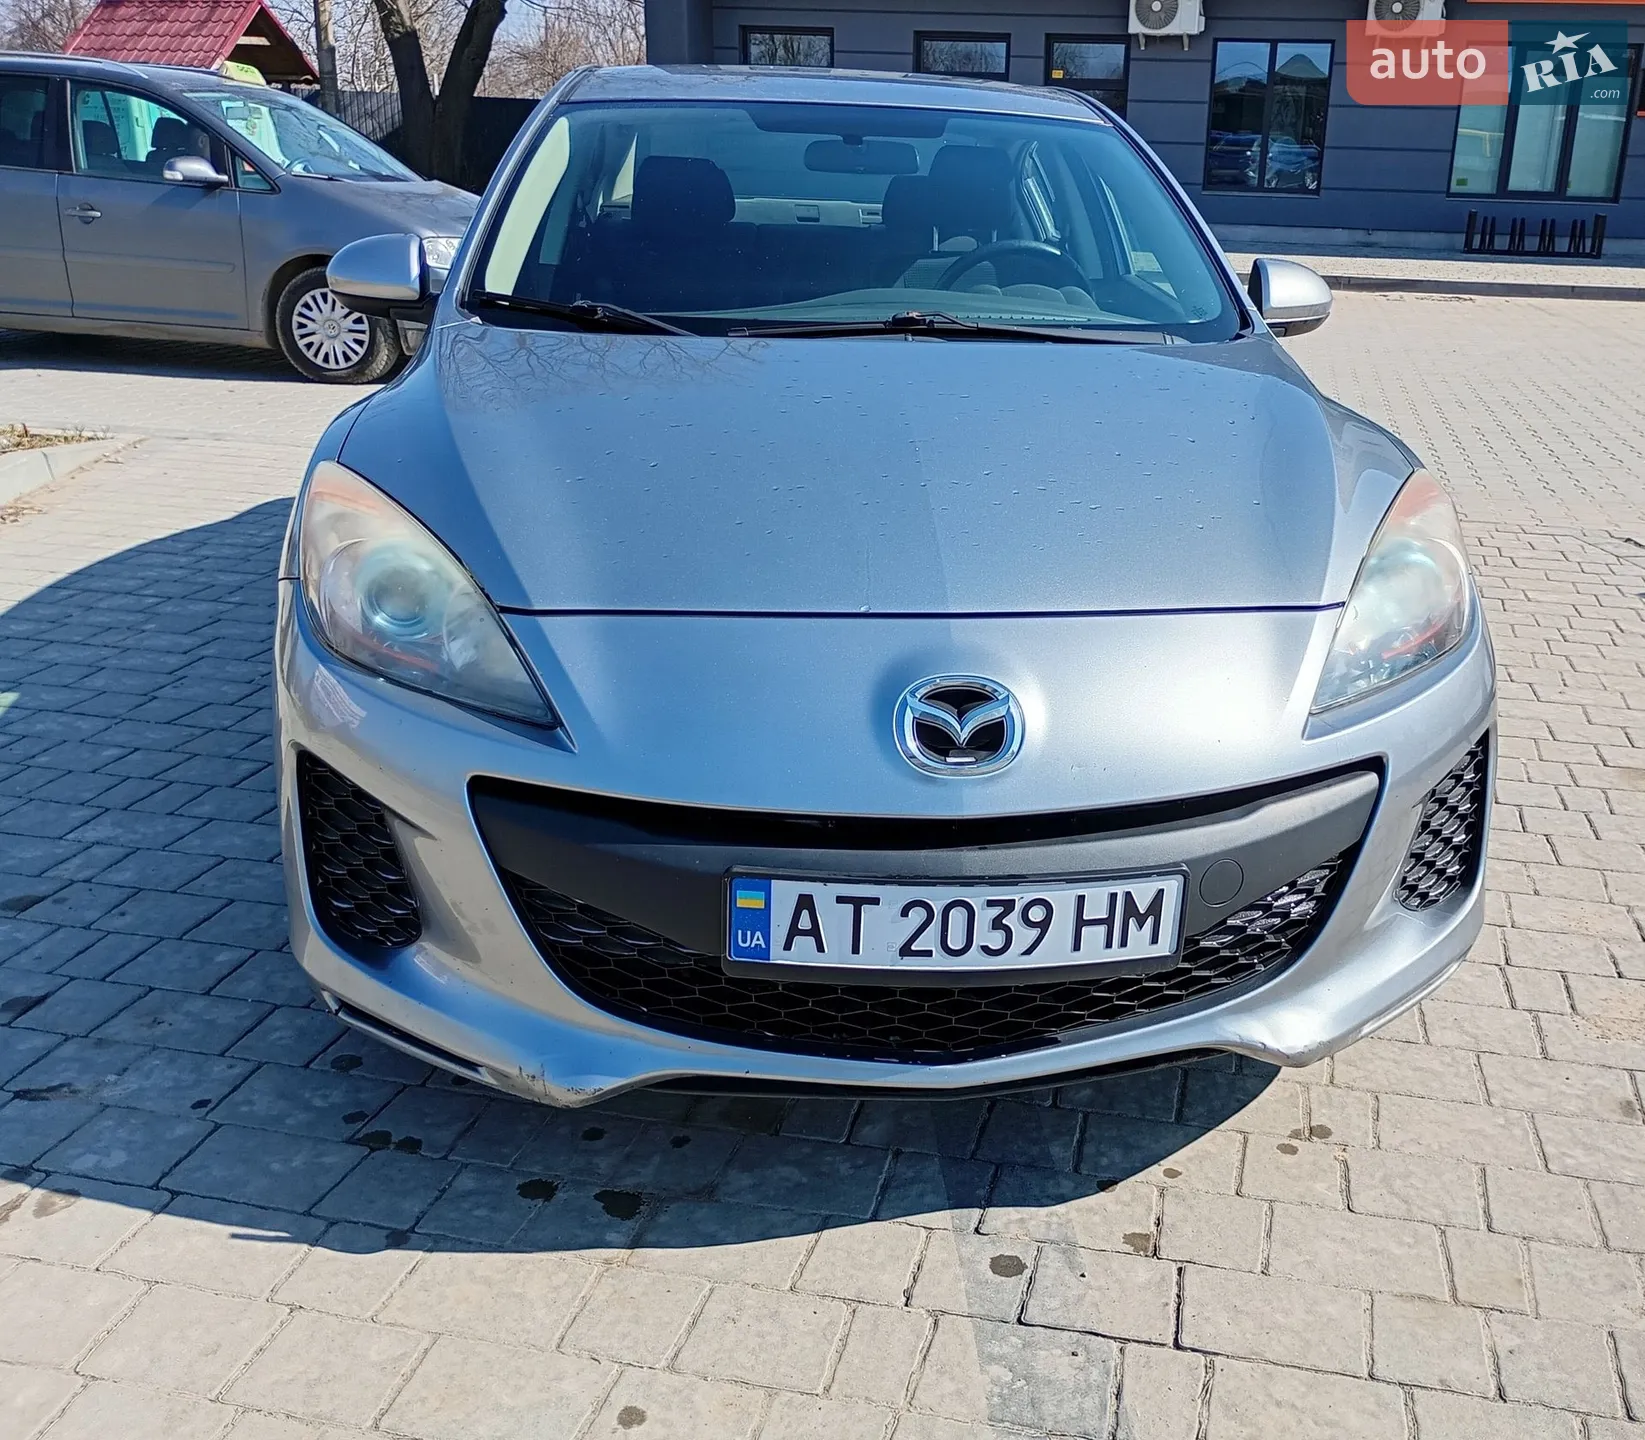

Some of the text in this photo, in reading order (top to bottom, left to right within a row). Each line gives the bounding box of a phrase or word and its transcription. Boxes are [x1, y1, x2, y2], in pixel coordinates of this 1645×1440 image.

[737, 930, 766, 949] UA
[782, 887, 1165, 958] AT 2039 HM
